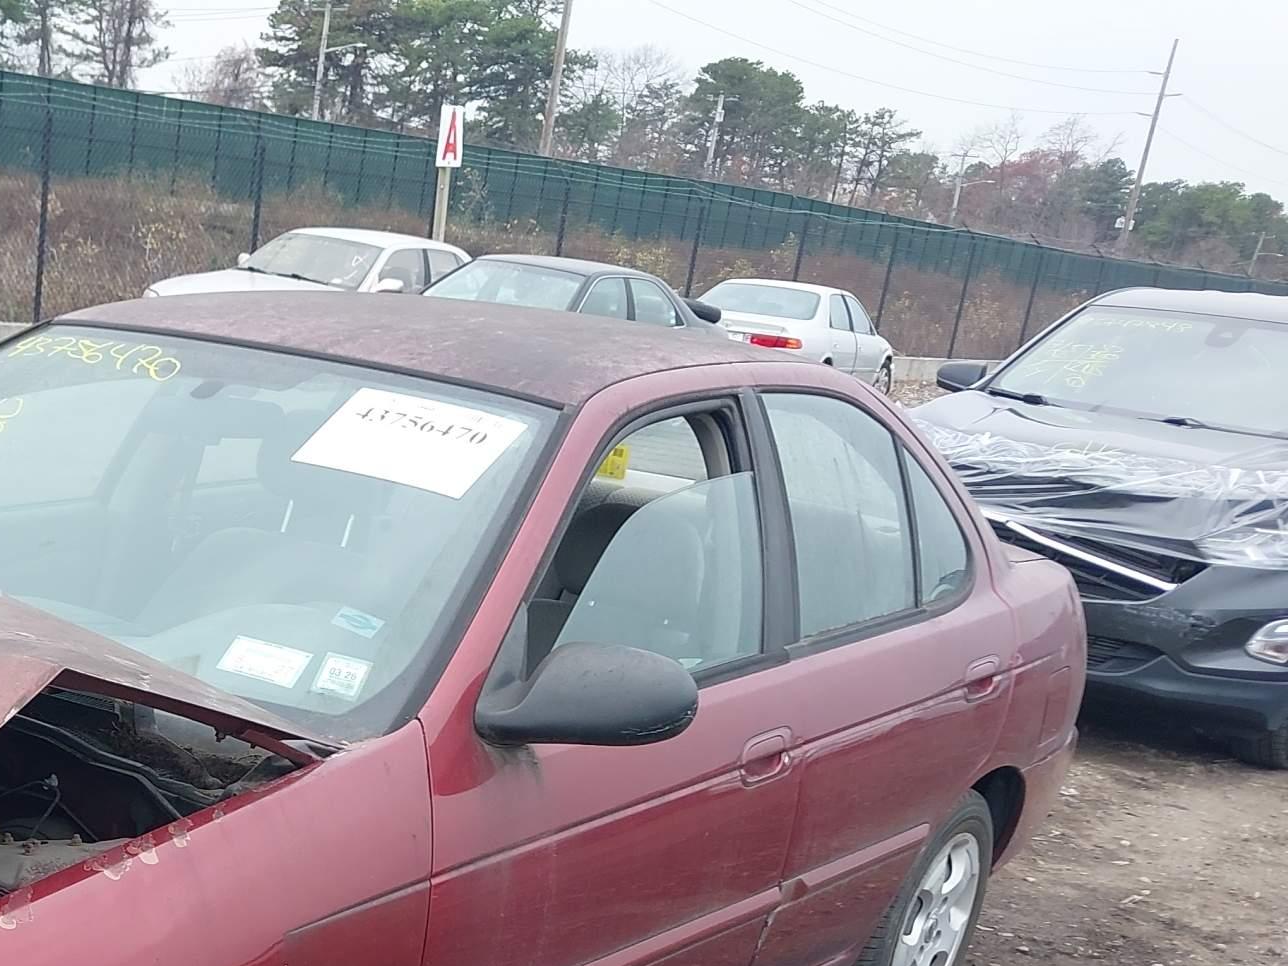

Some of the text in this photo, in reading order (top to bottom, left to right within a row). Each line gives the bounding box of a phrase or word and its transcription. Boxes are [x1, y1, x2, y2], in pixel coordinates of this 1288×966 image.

[441, 107, 457, 161] A
[7, 335, 182, 382] 43756470
[354, 407, 489, 445] 43756470
